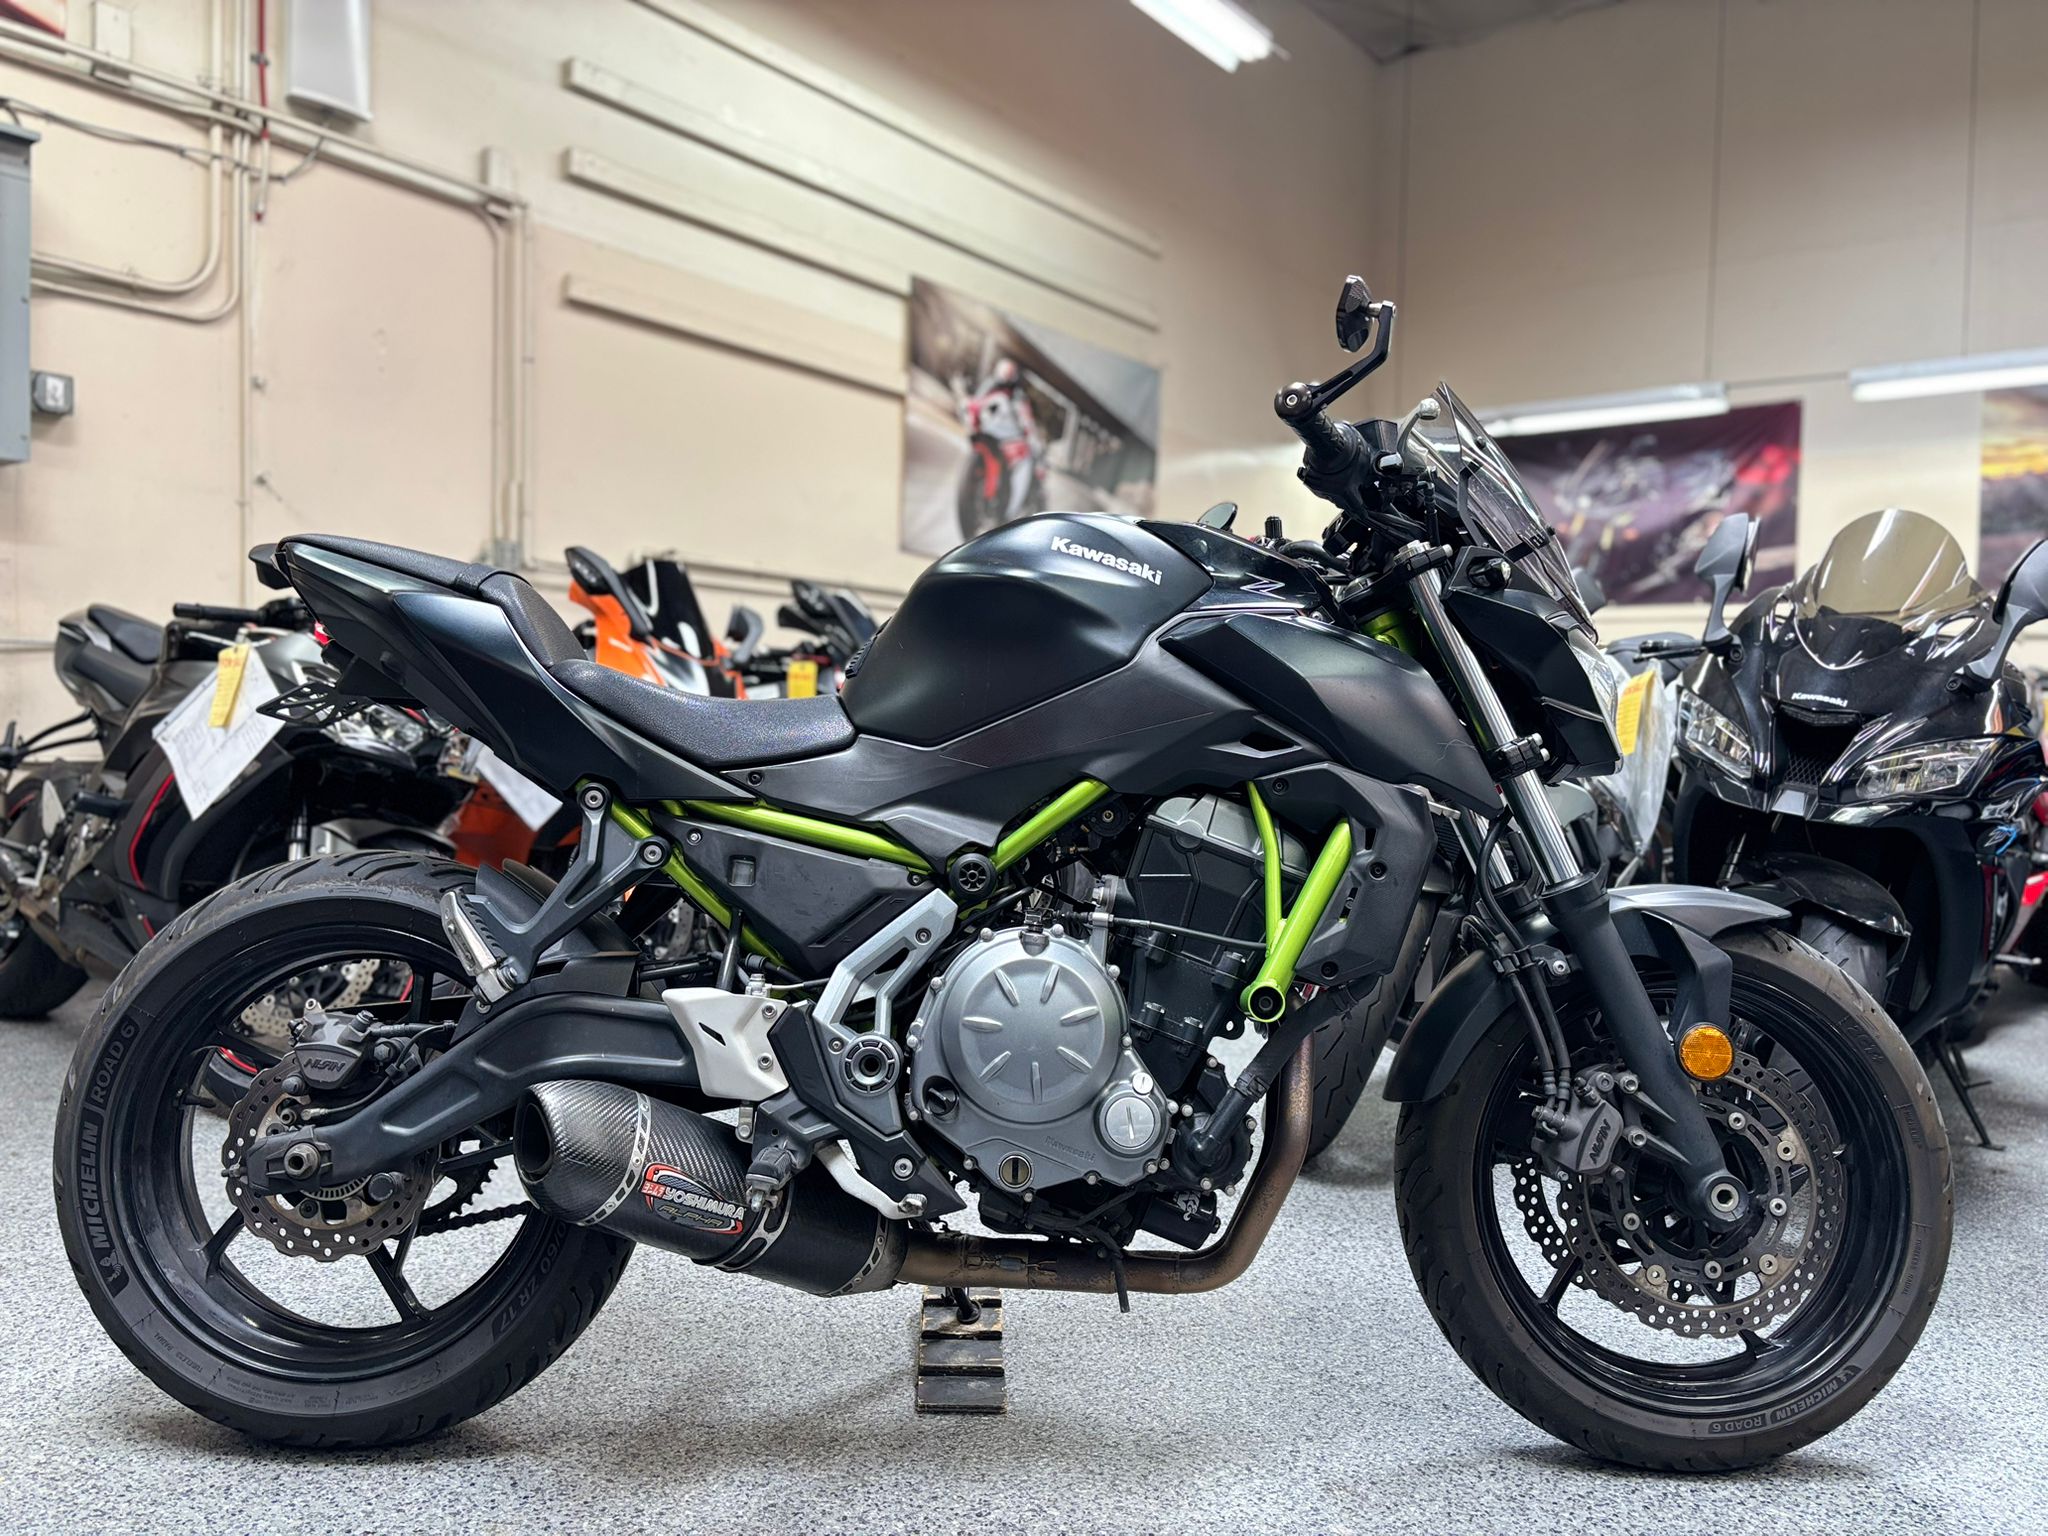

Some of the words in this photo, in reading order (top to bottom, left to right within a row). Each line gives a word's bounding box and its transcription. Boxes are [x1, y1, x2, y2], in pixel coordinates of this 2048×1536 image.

[1051, 536, 1162, 586] Kawasaki
[1791, 692, 1848, 708] Kawasaki
[120, 1023, 136, 1040] 6
[91, 1043, 125, 1104] ROAD
[80, 1121, 108, 1249] MICHELIN
[662, 1186, 745, 1221] YOSHIMURA
[540, 1221, 567, 1275] 0/60
[1776, 1378, 1839, 1421] MICHELIN
[1712, 1422, 1722, 1433] 6
[1725, 1416, 1762, 1433] ROAD
